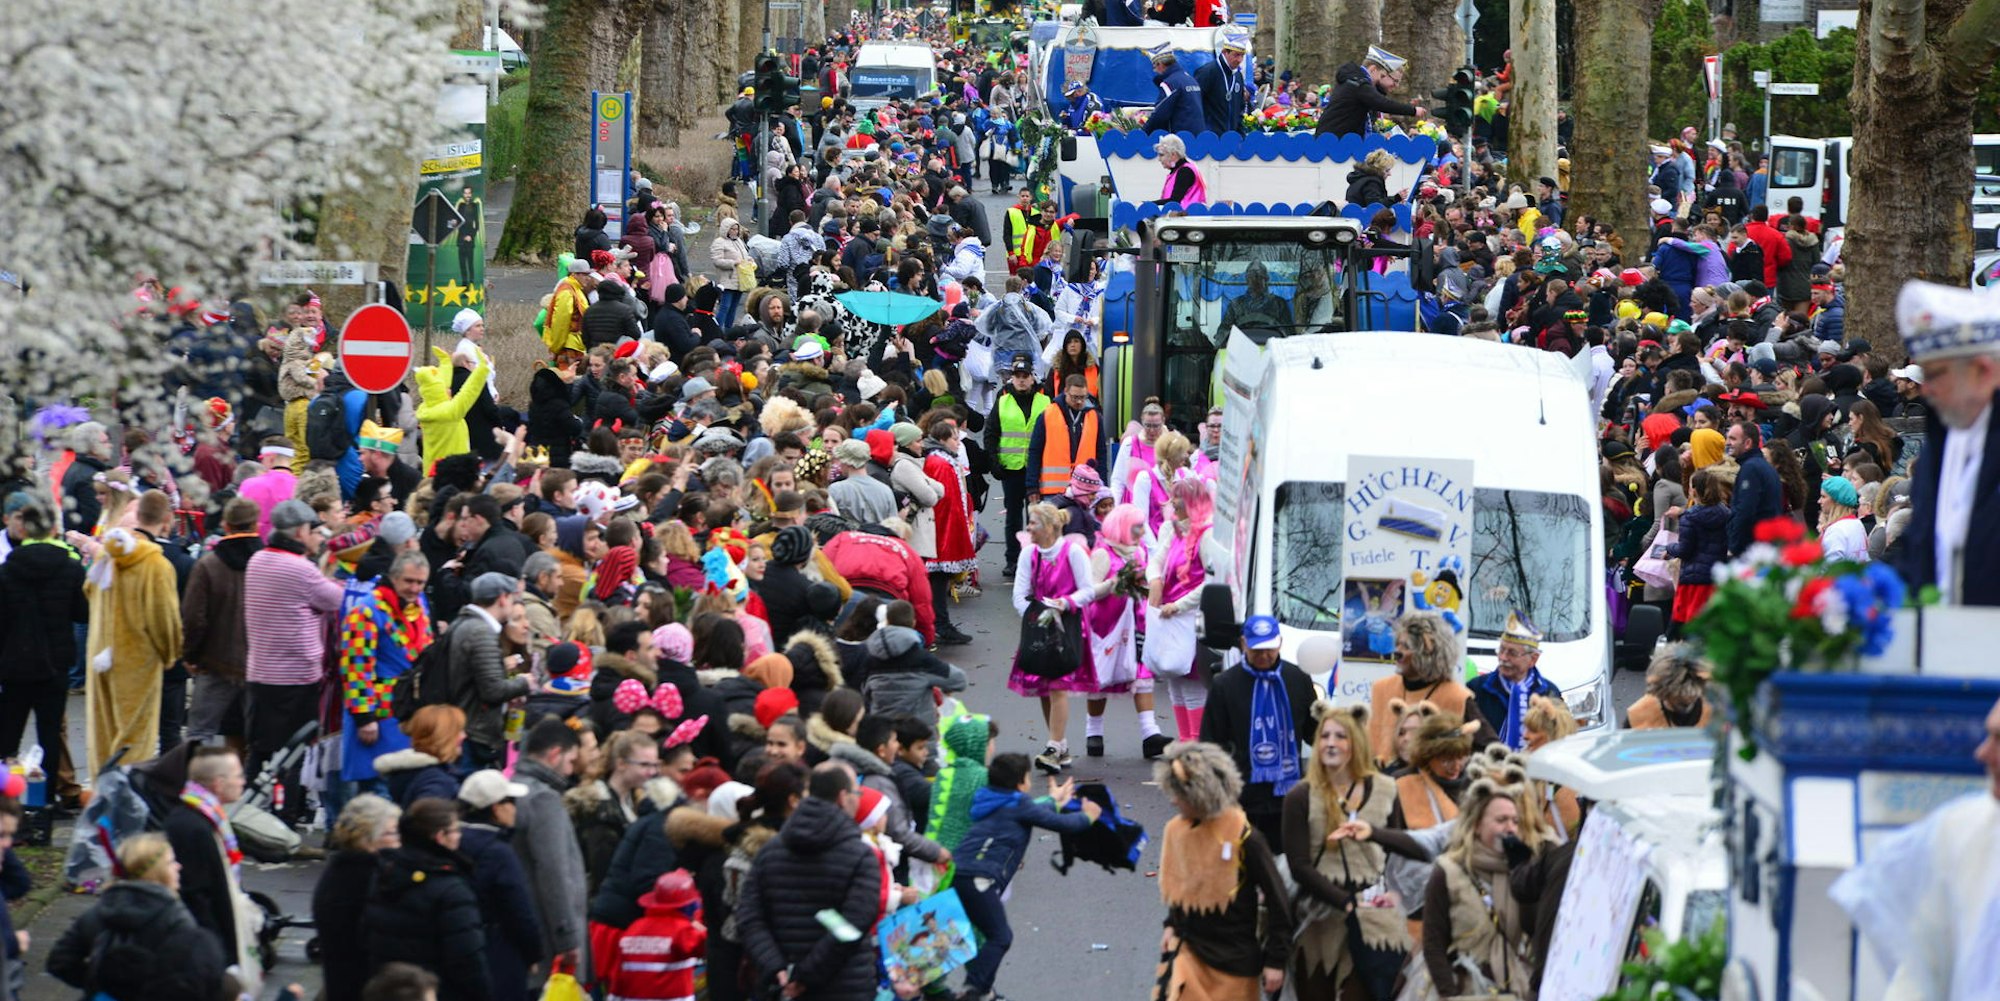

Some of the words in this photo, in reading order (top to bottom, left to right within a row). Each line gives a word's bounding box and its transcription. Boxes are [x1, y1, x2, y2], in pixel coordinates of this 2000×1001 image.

[1826, 445, 1838, 457] BI
[1347, 467, 1472, 514] HÜCHELN
[1350, 548, 1396, 566] Fidele
[1410, 549, 1431, 570] T.
